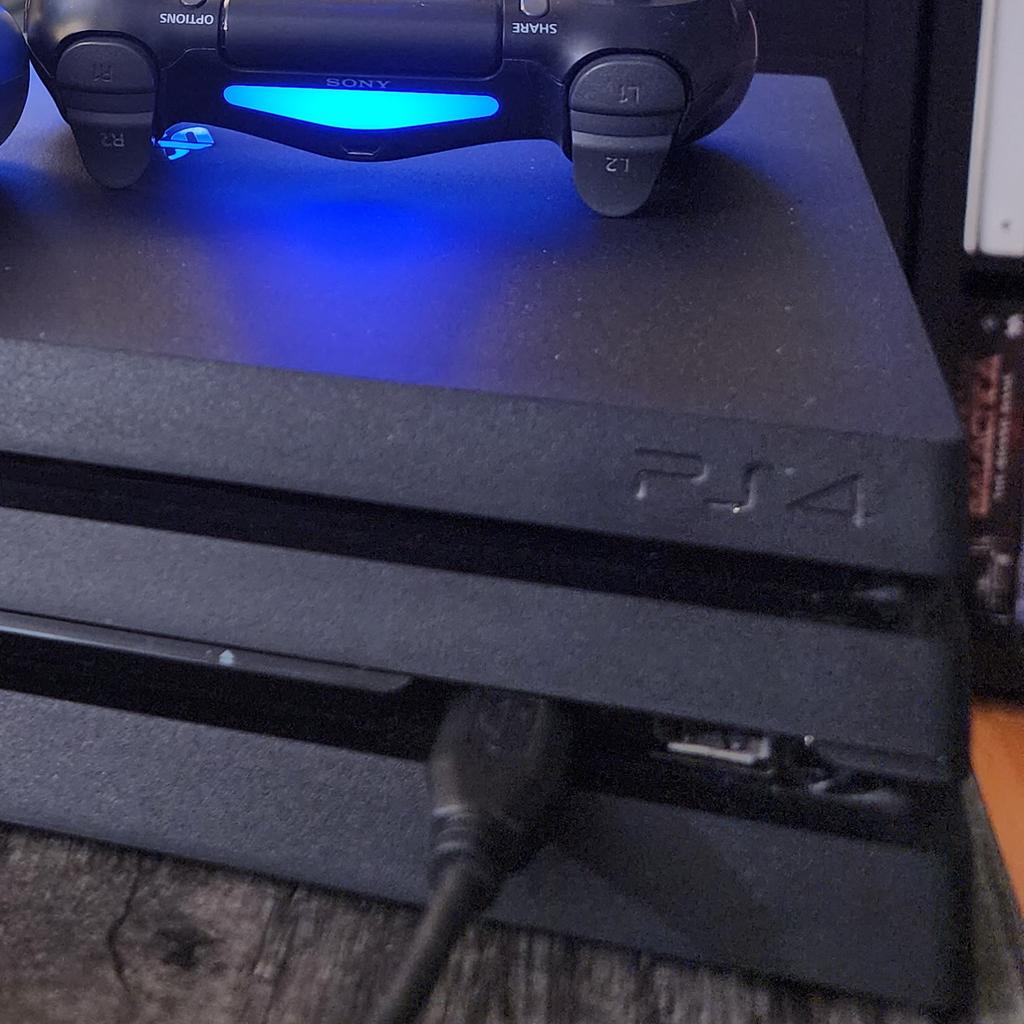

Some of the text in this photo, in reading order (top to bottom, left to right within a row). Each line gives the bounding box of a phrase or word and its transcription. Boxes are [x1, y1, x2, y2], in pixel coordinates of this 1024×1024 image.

[159, 13, 214, 25] OPTIONS
[512, 22, 557, 34] SHARE
[326, 78, 391, 88] SONY
[618, 86, 640, 104] L1
[100, 132, 125, 148] R2
[605, 157, 629, 172] L2
[633, 446, 871, 528] PS4
